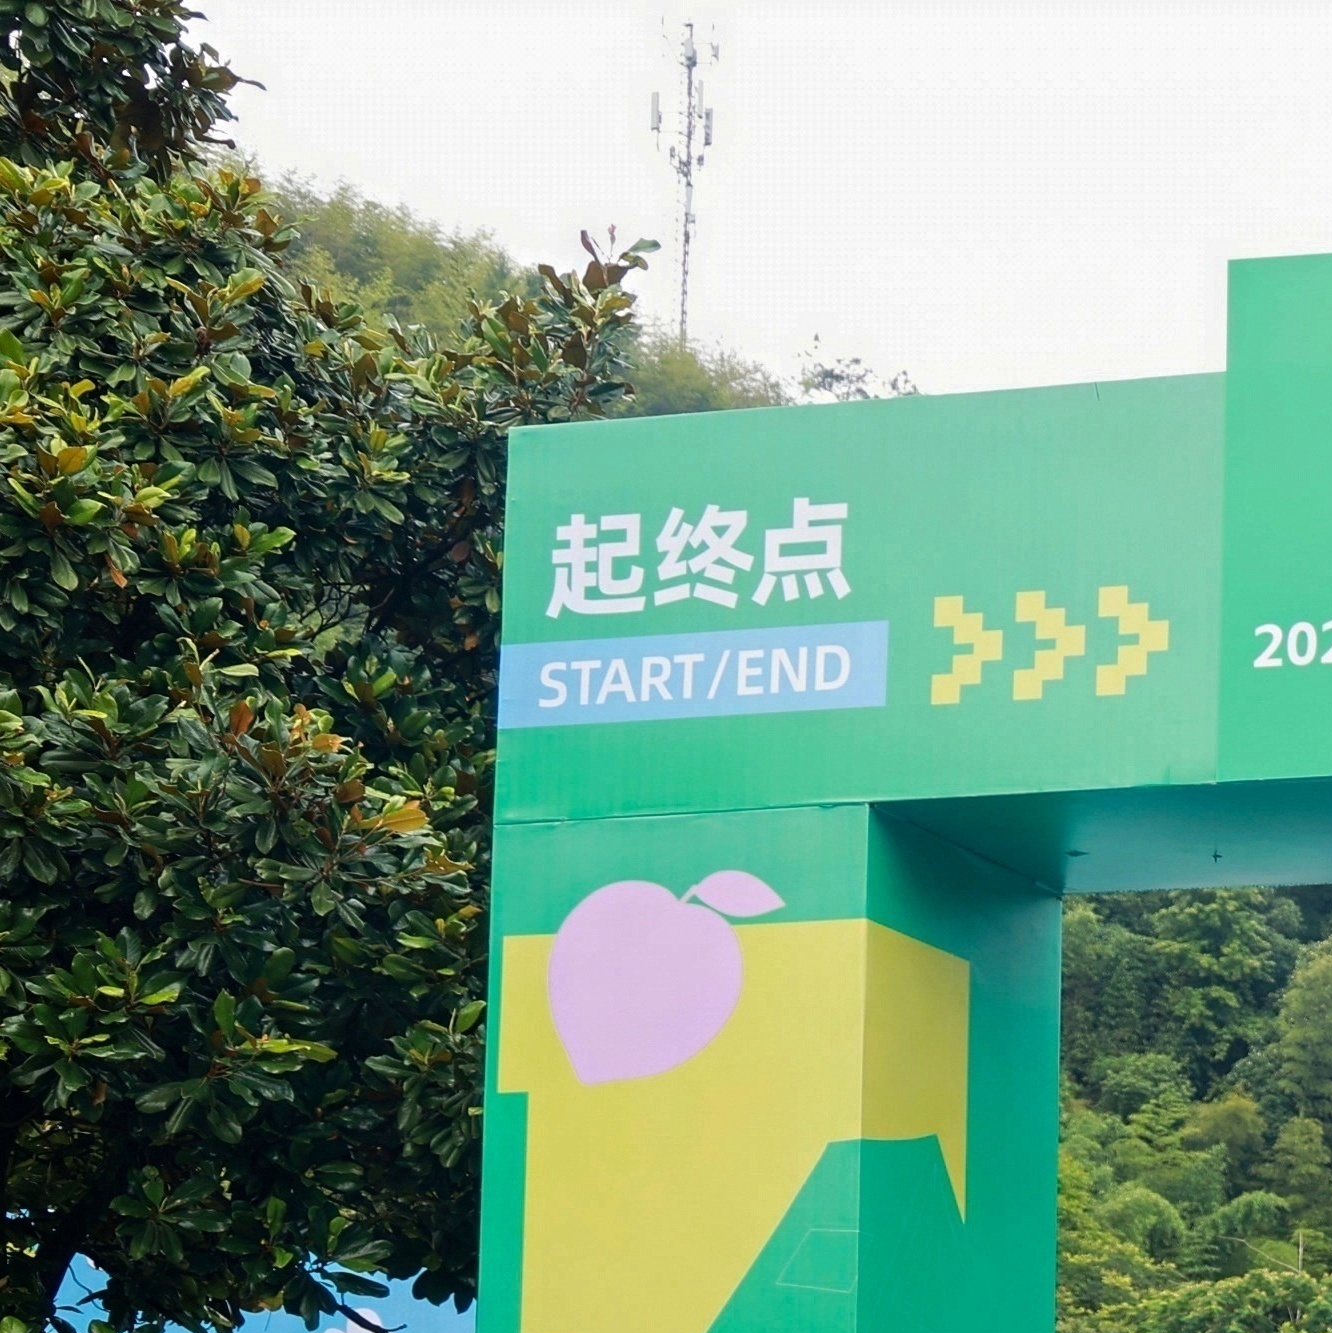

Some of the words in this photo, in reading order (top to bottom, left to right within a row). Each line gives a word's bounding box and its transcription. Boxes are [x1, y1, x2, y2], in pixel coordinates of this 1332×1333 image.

[546, 497, 851, 618] 起终点
[540, 645, 852, 707] START/END
